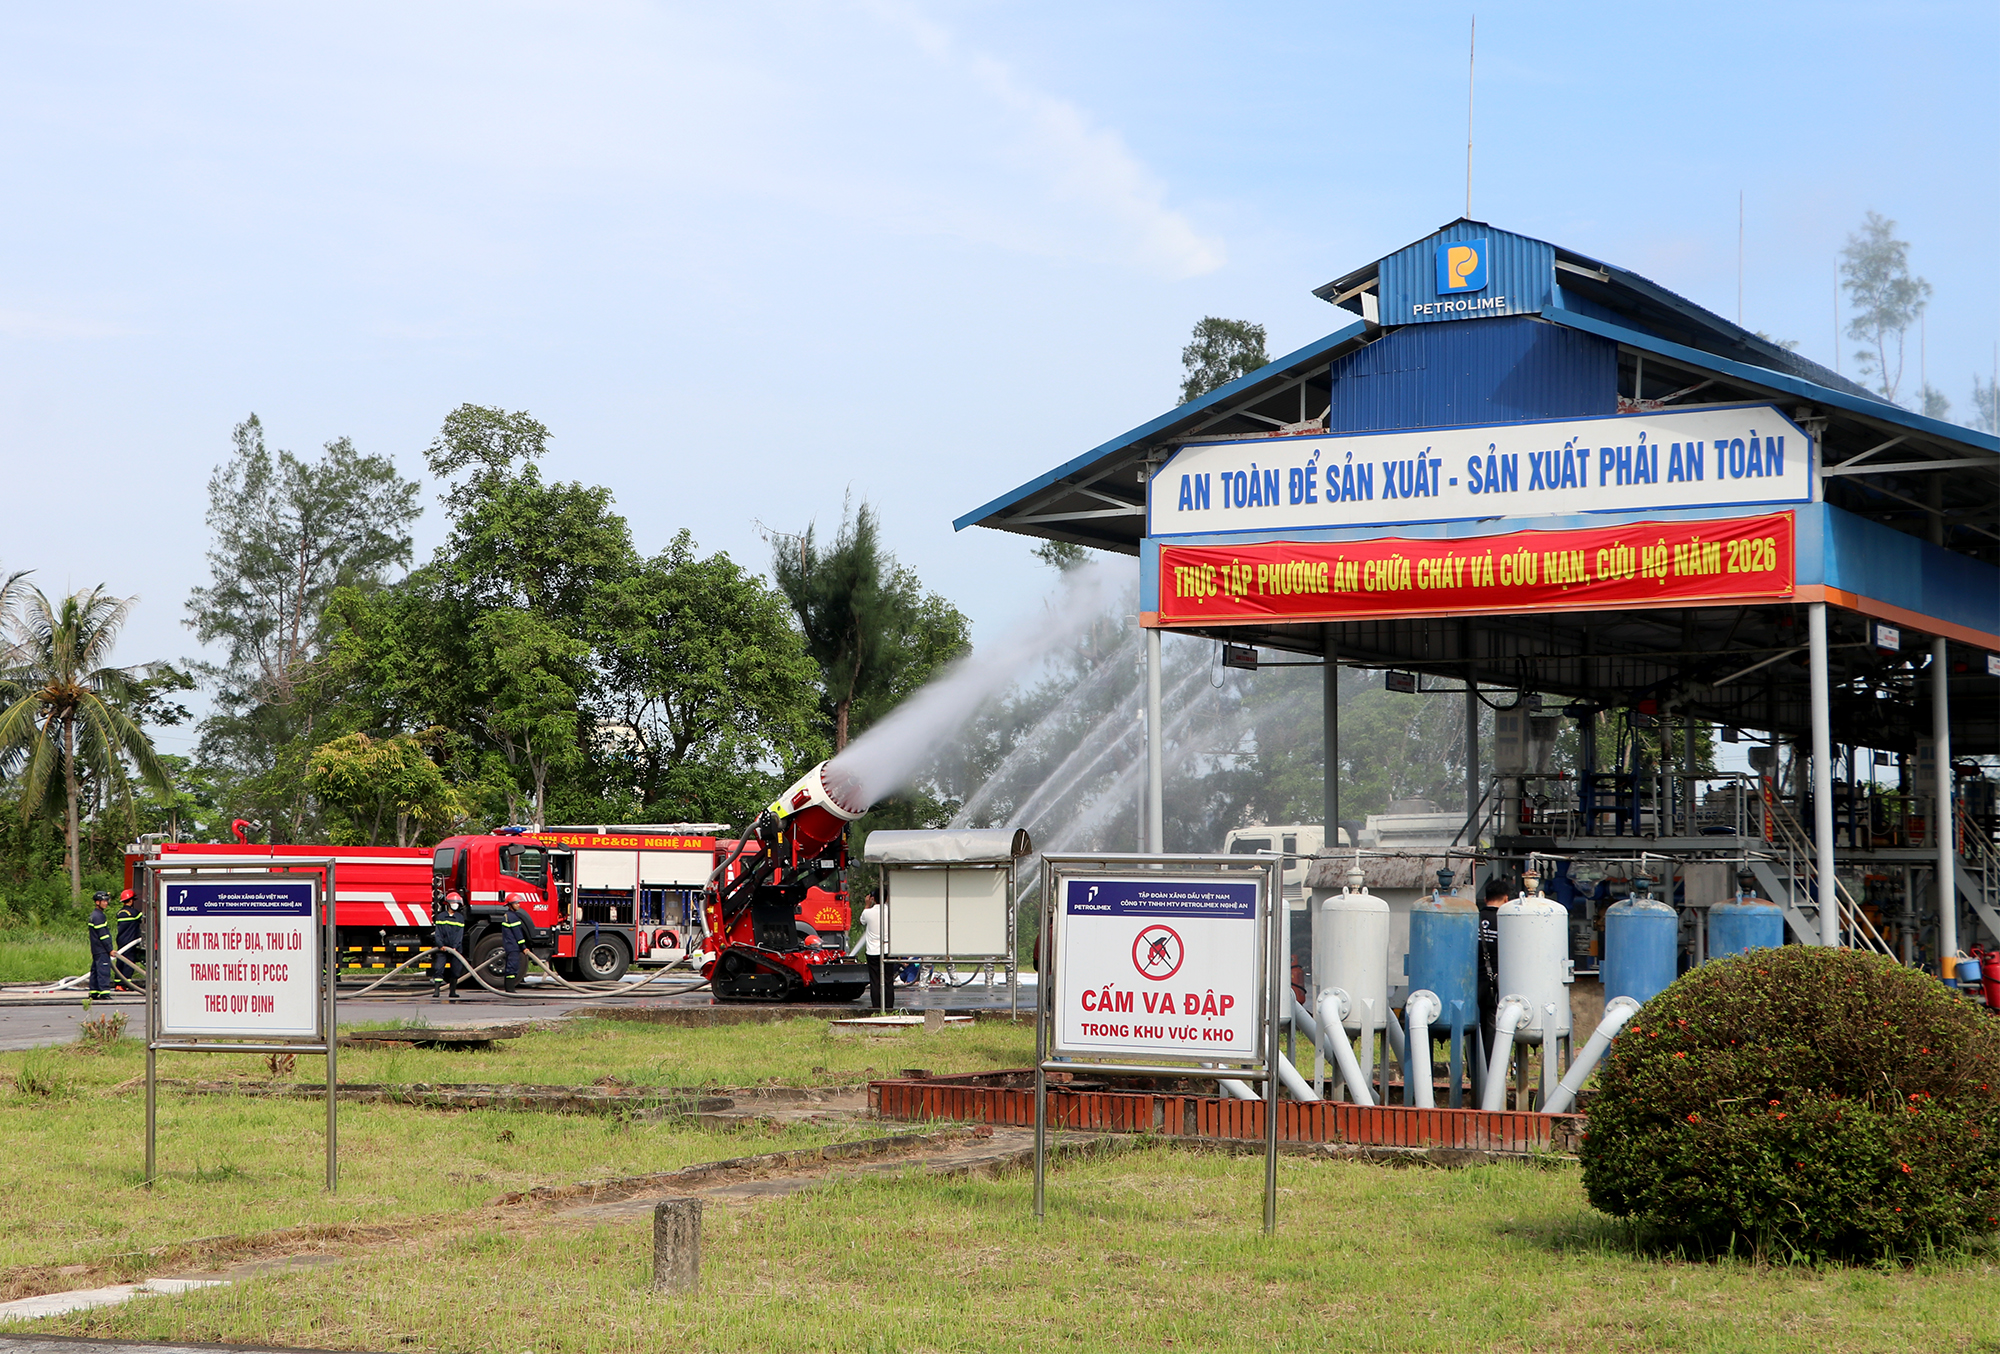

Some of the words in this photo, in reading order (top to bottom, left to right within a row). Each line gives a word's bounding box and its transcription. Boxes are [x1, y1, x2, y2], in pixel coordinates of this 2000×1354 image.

[1413, 296, 1505, 315] PETROLIME
[1178, 473, 1210, 511] AN
[1221, 463, 1279, 508] TOÀN
[1289, 449, 1318, 505] ĐỂ
[1326, 451, 1373, 502] SẢN
[1382, 446, 1442, 499] XUẤT
[1468, 443, 1518, 494] SẢN
[1529, 436, 1590, 491] XUẤT
[1600, 431, 1658, 486] PHẢI
[1668, 441, 1704, 483] AN
[1714, 429, 1784, 480] TOÀN
[1174, 563, 1217, 604] THỰC
[1221, 558, 1253, 603] TẬP
[1258, 559, 1328, 595] PHƯƠNG
[1334, 555, 1359, 592] ÁN
[1363, 553, 1412, 592] CHỮA
[1417, 551, 1466, 589] CHÁY
[1471, 549, 1495, 588] VÀ
[1500, 546, 1538, 586] CỨU
[1544, 550, 1590, 590] NẠN,
[1596, 541, 1636, 581] CỨU
[1642, 538, 1667, 585] HỘ
[1674, 536, 1721, 577] NĂM
[1727, 537, 1776, 573] 2026
[561, 835, 587, 845] SÁT
[592, 837, 638, 846] PC&CC
[644, 837, 679, 849] NGHỆ
[683, 839, 702, 848] AN
[1138, 891, 1150, 900] TẬP
[1150, 891, 1168, 899] ĐOÀN
[1201, 892, 1214, 900] VIỆT
[177, 925, 200, 950] KIỂM
[203, 933, 220, 950] TRA
[222, 926, 242, 950] TIẾP
[245, 933, 264, 954] ĐỊA,
[266, 933, 284, 950] THU
[287, 928, 302, 950] LÔI
[190, 964, 220, 981] TRANG
[223, 958, 248, 981] THIẾT
[251, 964, 260, 985] BỊ
[263, 964, 288, 981] PCCC
[205, 995, 228, 1012] THEO
[230, 995, 248, 1015] QUY
[251, 995, 274, 1017] ĐỊNH
[1082, 983, 1134, 1013] CẤM
[1142, 992, 1176, 1014] VA
[1183, 989, 1234, 1021] ĐẬP
[1081, 1023, 1129, 1037] TRONG
[1134, 1026, 1163, 1038] KHU
[1168, 1025, 1198, 1043] VỰC
[1203, 1028, 1234, 1041] KHO
